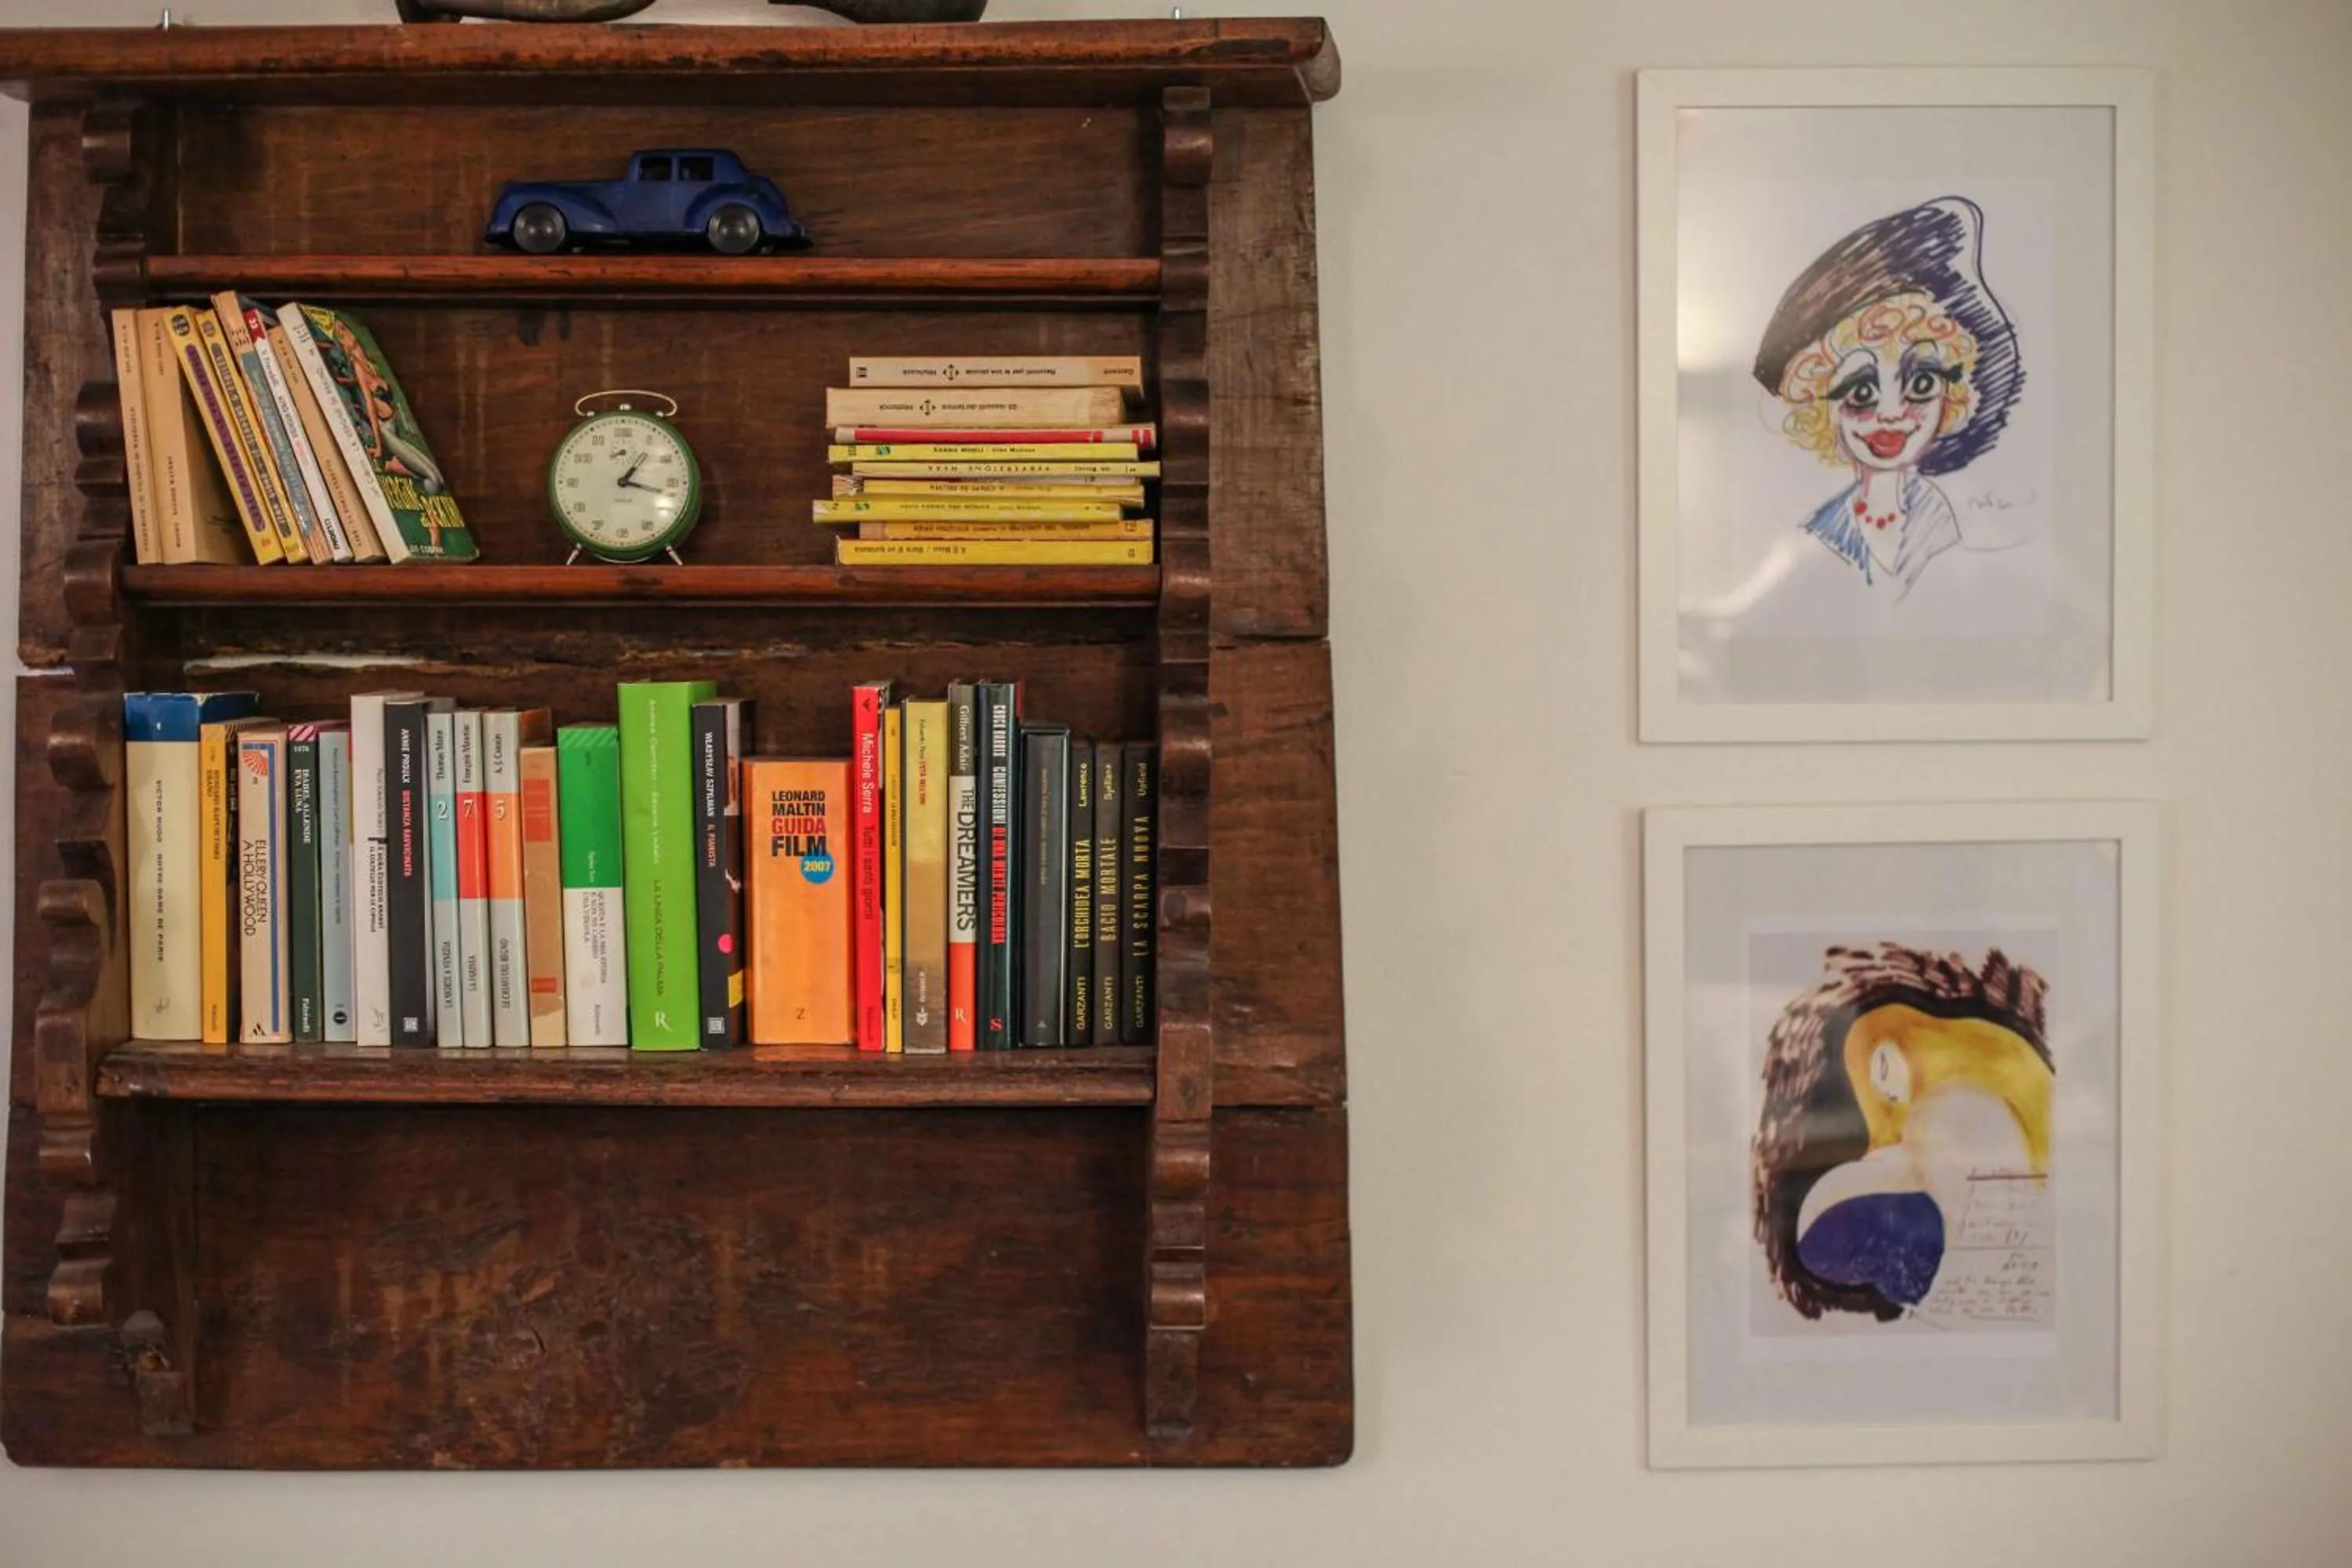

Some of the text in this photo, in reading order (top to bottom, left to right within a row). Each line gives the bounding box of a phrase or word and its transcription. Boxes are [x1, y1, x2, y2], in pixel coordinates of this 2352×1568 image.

[401, 728, 411, 783] ANNIE PROULX
[958, 705, 970, 771] Gilbert Adair
[993, 730, 1007, 757] BARRIS
[862, 733, 875, 813] Michele Serra
[1077, 762, 1089, 808] Lawrence
[1102, 763, 1115, 800] Spillane
[1136, 762, 1149, 797] Upfield
[301, 768, 311, 844] ISABEL ALLENDE
[438, 801, 448, 820] 2
[463, 799, 474, 818] 7
[771, 789, 826, 801] LEONARD
[771, 802, 826, 815] MALTIN
[992, 766, 1007, 824] CONFESSIONI
[401, 789, 412, 877] DISTANZA RAVVICINATA
[771, 818, 826, 834] GUIDA
[863, 826, 874, 848] Tutti
[707, 833, 717, 868] PIANISTA
[771, 835, 827, 857] FILM
[957, 789, 976, 931] THE DREAMERS
[255, 840, 267, 923] ELLERY QUEEN
[802, 860, 830, 872] 2007
[863, 858, 873, 885] santi
[991, 860, 1007, 887] MENTE
[243, 840, 256, 936] A HOLLYWOOD
[862, 887, 875, 920] giorni
[1074, 839, 1091, 948] L'ORCHIDEA MORTA
[1099, 838, 1117, 942] BACIO MORTALE
[1132, 815, 1150, 956] LA SCARPA NUOVA
[991, 891, 1007, 945] PERICOLOSA
[655, 927, 663, 960] DELLA
[955, 1008, 967, 1022] R
[1076, 976, 1087, 1030] GARZANTI
[1103, 976, 1114, 1030] GARZANTI
[1134, 975, 1145, 1028] GARZANTI
[655, 1012, 672, 1031] R
